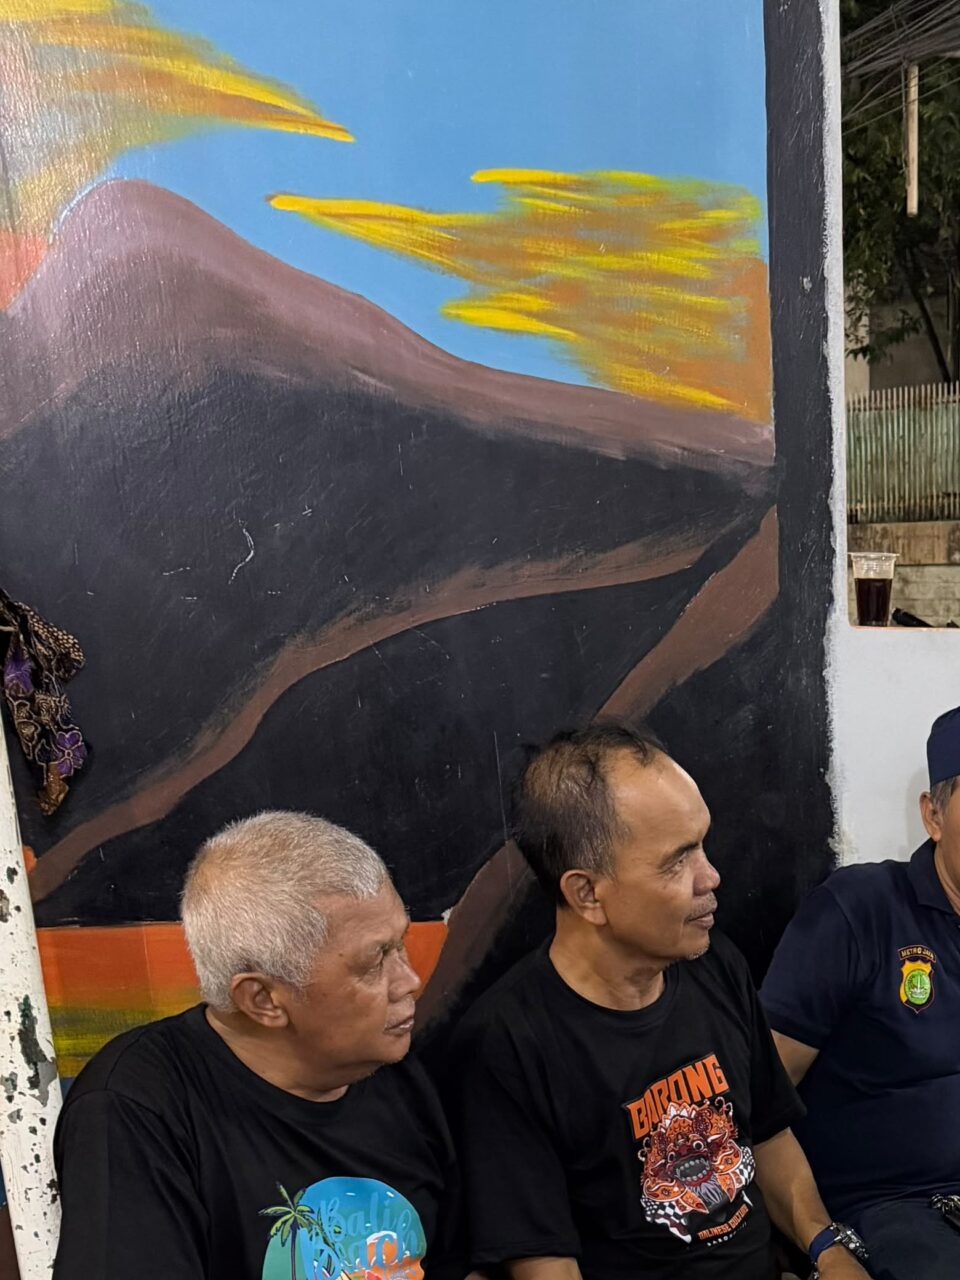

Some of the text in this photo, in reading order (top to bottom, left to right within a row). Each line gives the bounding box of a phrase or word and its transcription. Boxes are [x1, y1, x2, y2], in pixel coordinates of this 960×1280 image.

[901, 947, 922, 957] METRO
[626, 1053, 730, 1139] BARONG
[319, 1191, 393, 1242] Bali
